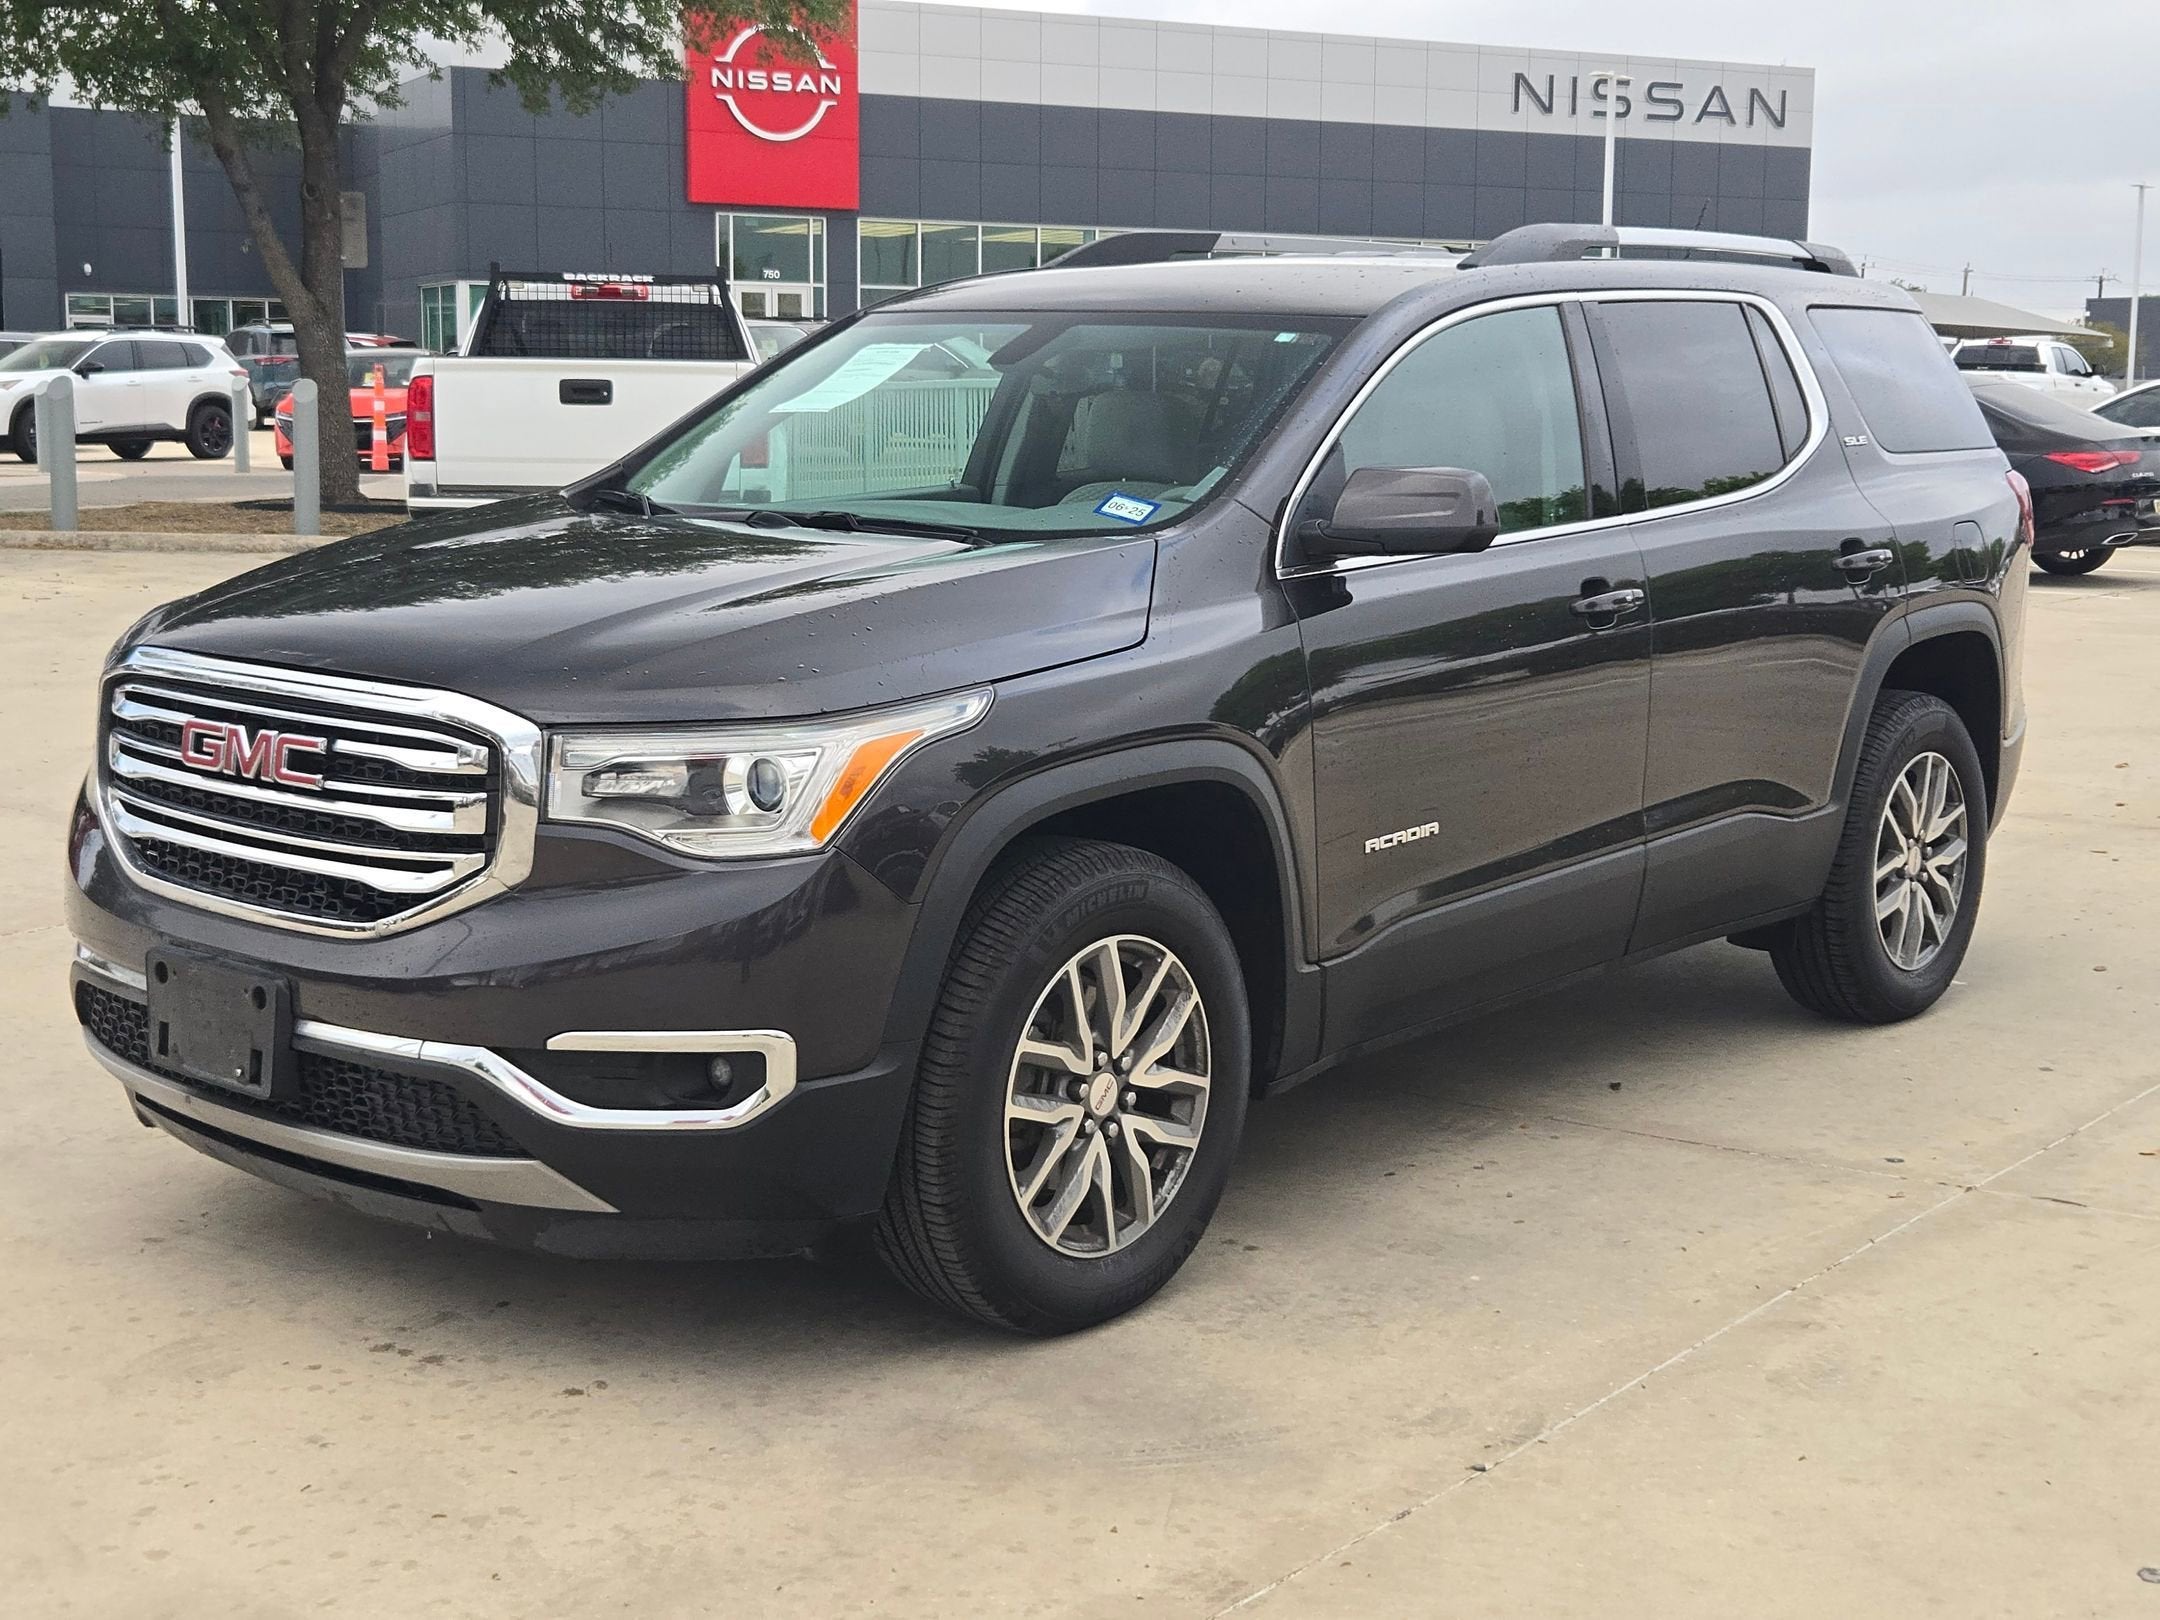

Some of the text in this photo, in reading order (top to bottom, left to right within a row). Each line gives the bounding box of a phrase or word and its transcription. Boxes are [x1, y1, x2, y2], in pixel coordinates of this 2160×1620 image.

[711, 68, 841, 95] NISSAN
[1511, 72, 1788, 128] NISSAN
[563, 272, 656, 283] BACKRACK
[763, 269, 780, 279] 750
[182, 718, 328, 791] GMC
[1364, 821, 1440, 854] ACADIA
[1095, 1078, 1114, 1111] GMC
